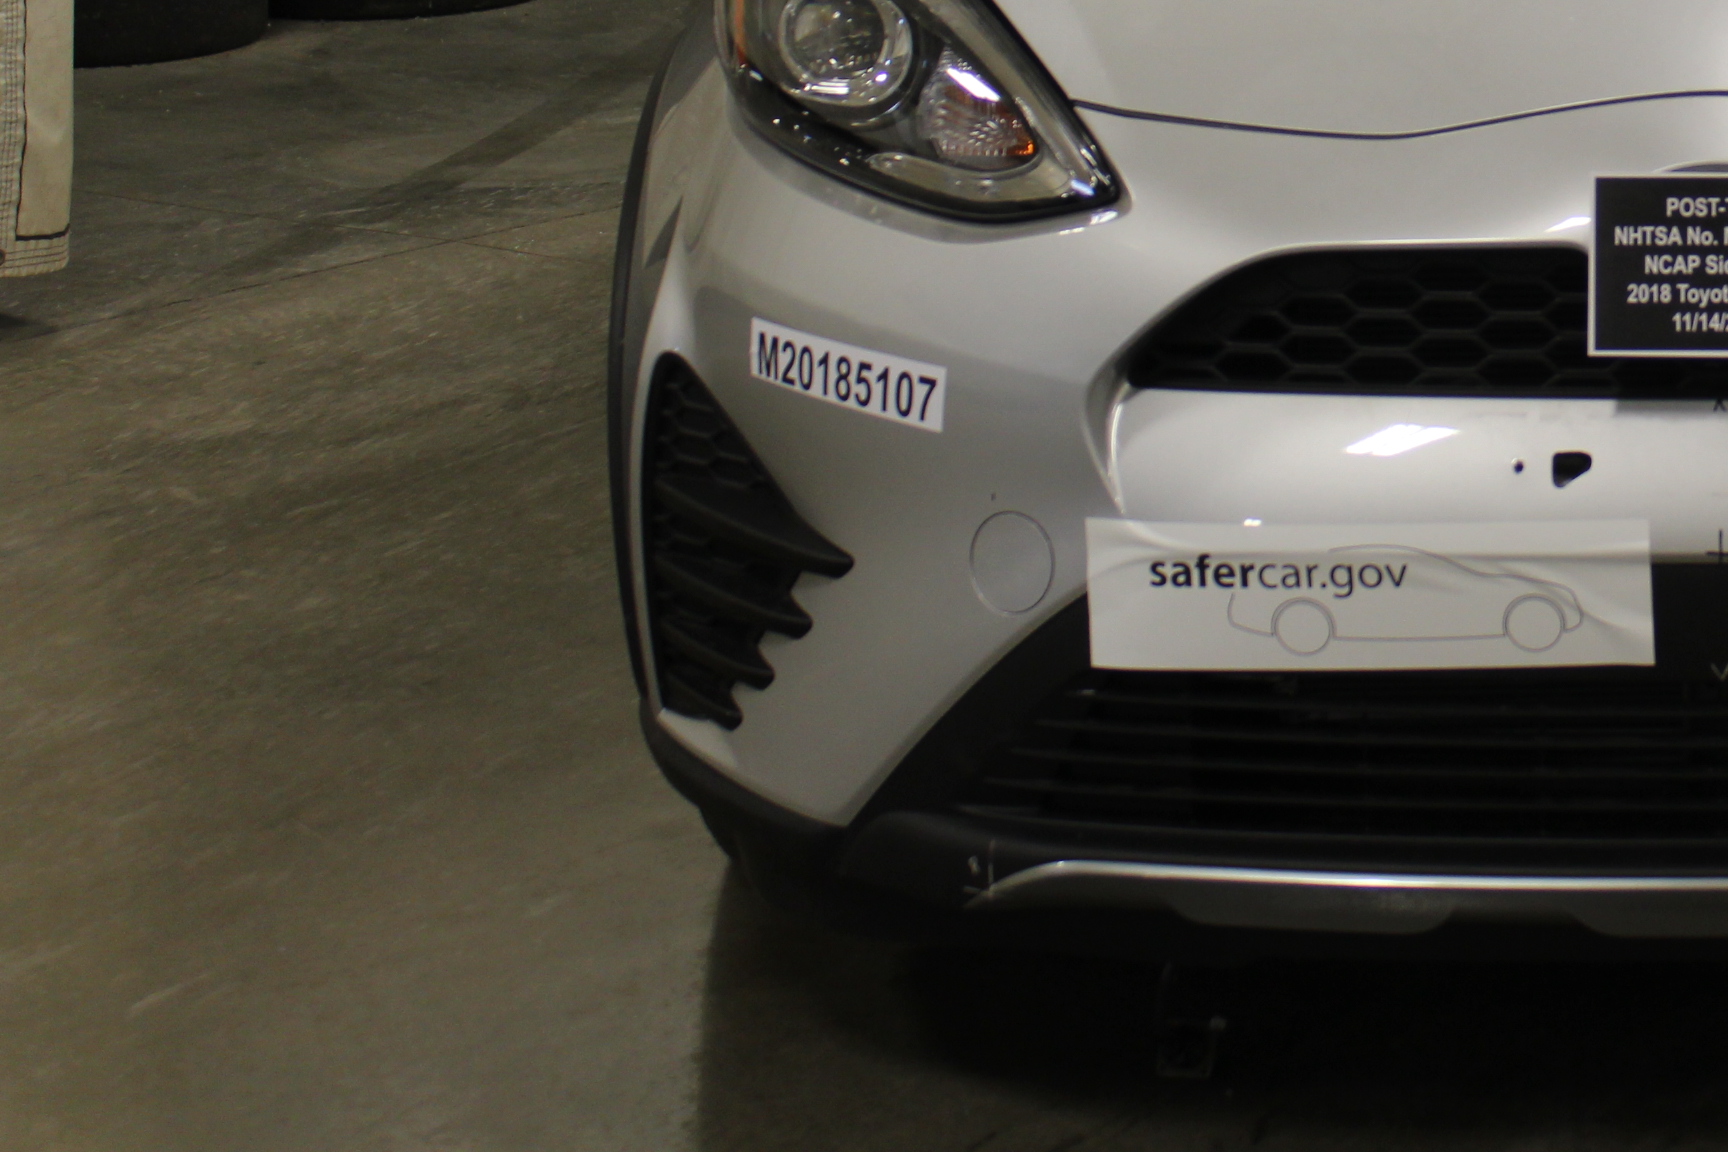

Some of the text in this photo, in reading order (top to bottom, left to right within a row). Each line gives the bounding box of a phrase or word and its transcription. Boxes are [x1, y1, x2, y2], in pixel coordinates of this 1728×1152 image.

[1614, 225, 1683, 246] NHTSA
[1686, 226, 1718, 246] No.
[1644, 254, 1701, 275] NCAP
[1627, 283, 1672, 304] 2018
[757, 332, 937, 422] M20185107
[1150, 553, 1407, 599] safercar.gov
